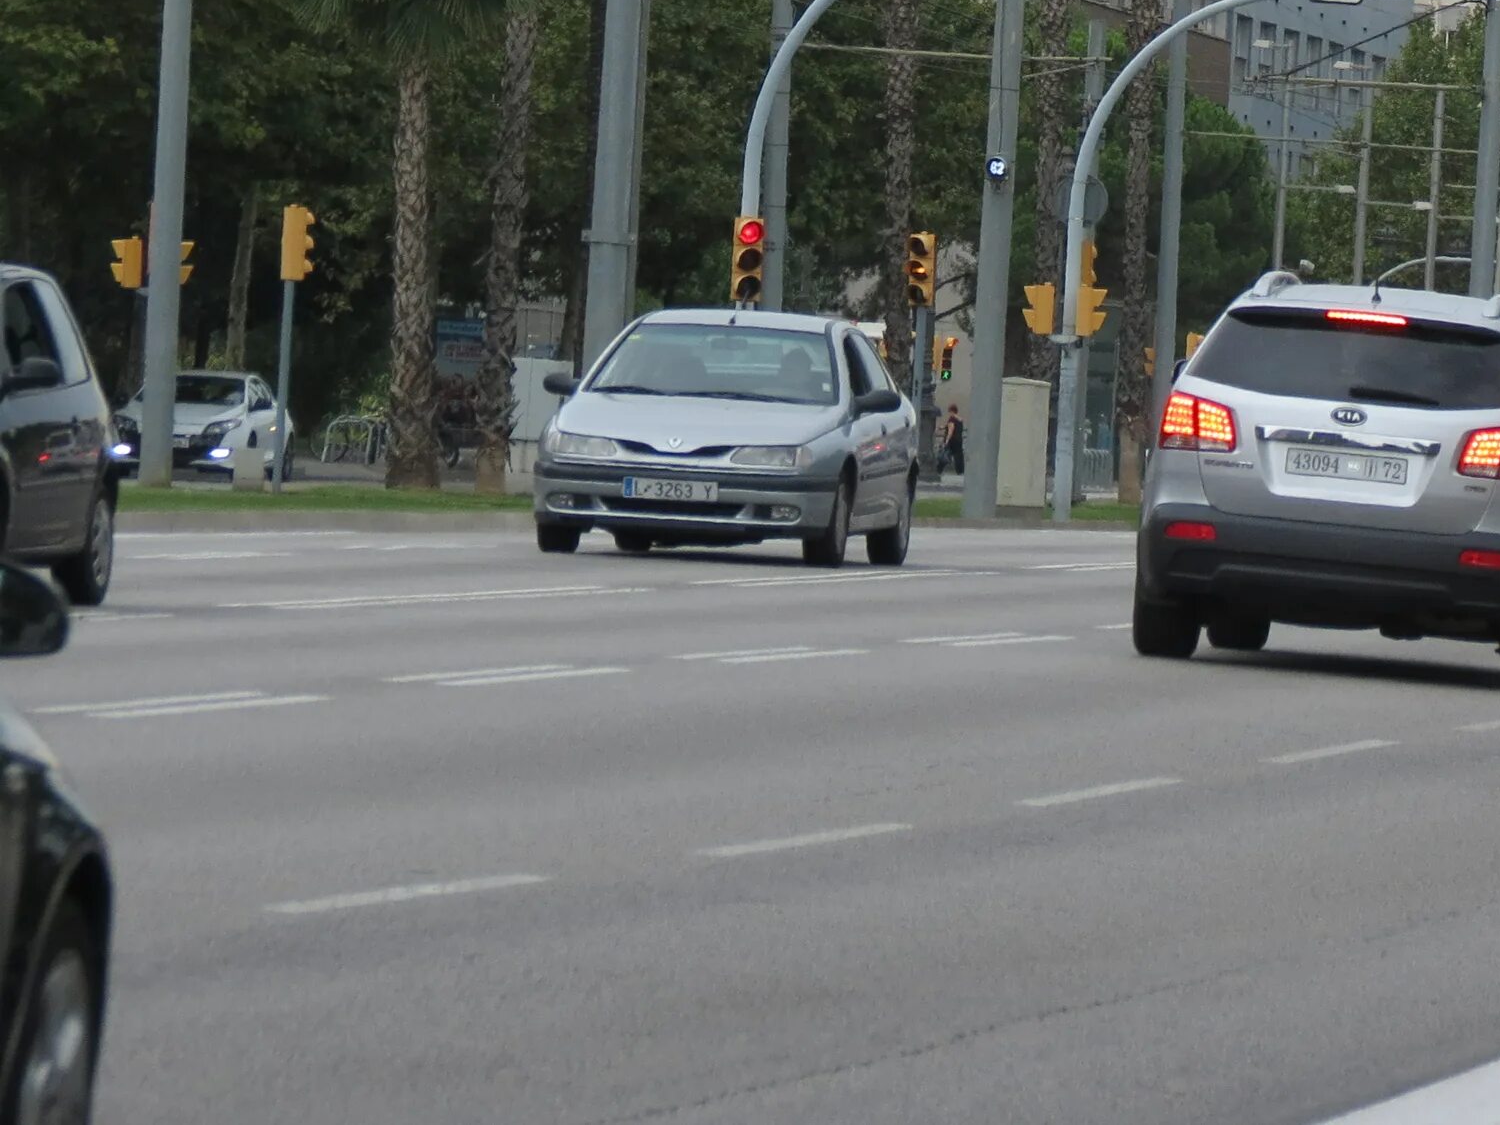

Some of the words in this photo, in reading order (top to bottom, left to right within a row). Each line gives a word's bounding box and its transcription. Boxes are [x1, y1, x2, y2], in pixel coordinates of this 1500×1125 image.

[1338, 411, 1360, 421] KIA
[1293, 453, 1340, 474] 43094
[1383, 460, 1402, 479] 72
[704, 485, 712, 499] Y
